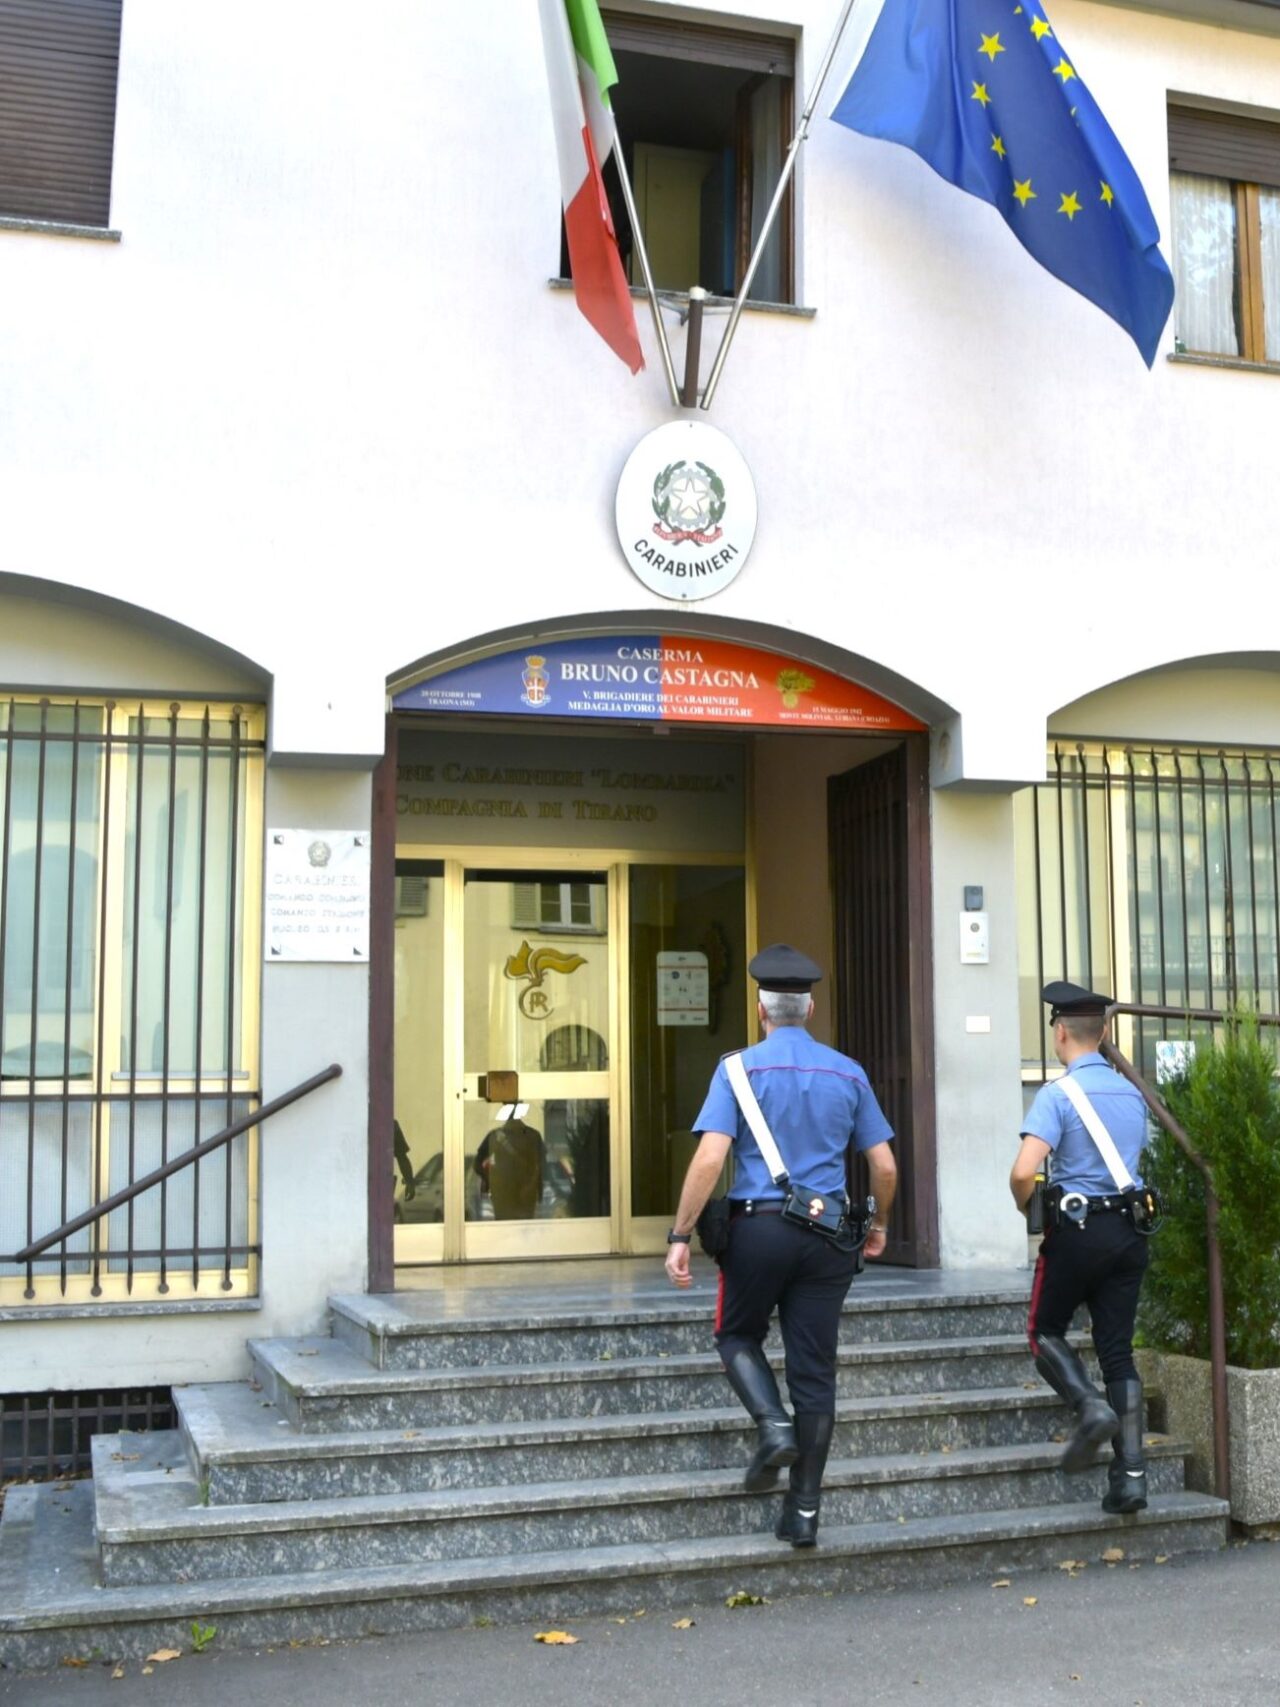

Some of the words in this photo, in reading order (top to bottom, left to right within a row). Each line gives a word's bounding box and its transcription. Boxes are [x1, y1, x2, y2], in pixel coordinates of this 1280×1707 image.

[634, 539, 739, 578] CARABINIERI
[617, 646, 703, 663] CASERMA
[560, 663, 638, 683] BRUNO
[643, 666, 759, 689] CASTAGNA
[568, 701, 622, 712] MEDAGLIA
[624, 703, 655, 713] D'ORO
[657, 705, 670, 714] AL
[671, 705, 704, 716] VALOR
[706, 707, 753, 718] MILITARE
[582, 691, 592, 700] V.
[594, 691, 654, 702] BRIGADIERE
[656, 694, 673, 703] DEI
[673, 695, 739, 706] CARABINIERI
[442, 761, 585, 789] CARABINIERI
[396, 794, 528, 819] COMPAGNIA
[538, 800, 563, 819] DI
[574, 799, 659, 824] TIRANO
